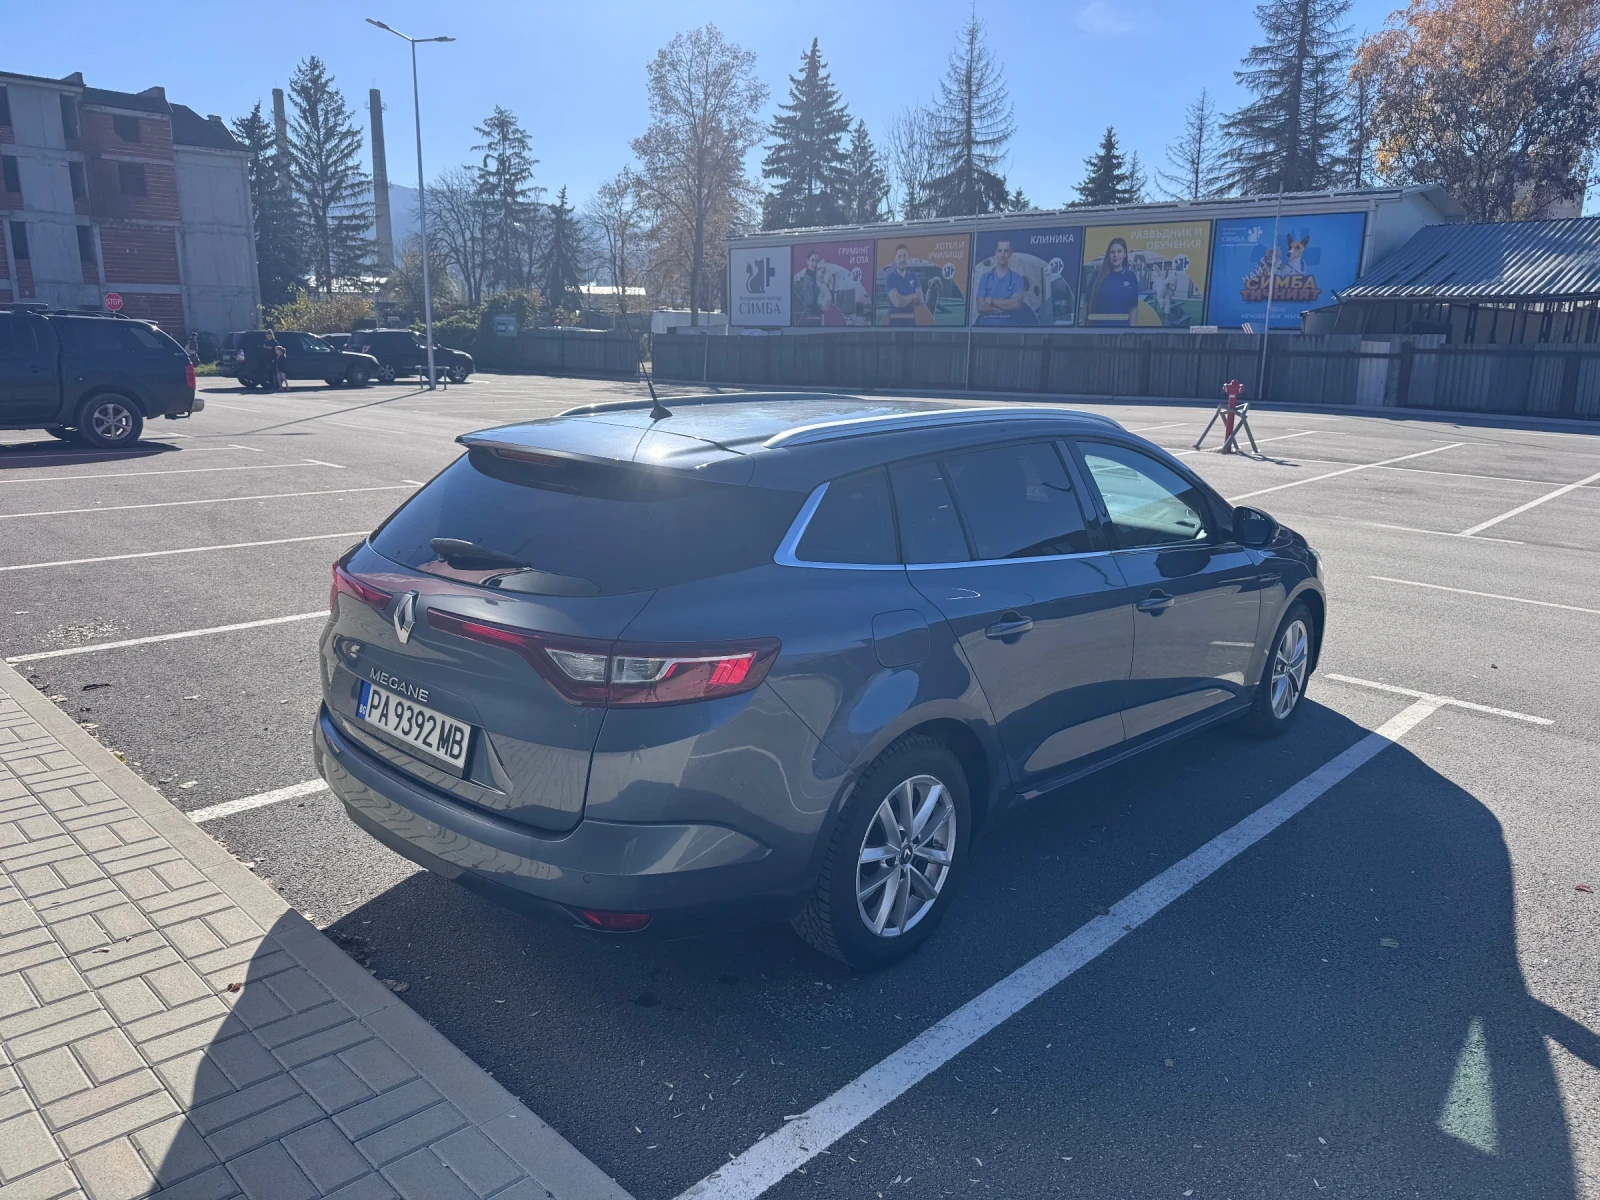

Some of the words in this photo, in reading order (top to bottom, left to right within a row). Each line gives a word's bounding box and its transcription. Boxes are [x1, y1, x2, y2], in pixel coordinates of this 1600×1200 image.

[1030, 233, 1075, 245] КЛИНИКА
[1130, 228, 1192, 239] РАЗВЪДНИК
[1195, 228, 1203, 237] И
[935, 242, 958, 250] ХОТЕЛ
[958, 241, 965, 249] И
[1146, 240, 1202, 250] ОБУЧЕНИЯ
[838, 246, 870, 256] ГРУМИНГ
[928, 250, 964, 260] УЧИЛИЩЕ
[849, 256, 855, 264] И
[856, 256, 869, 264] СПА
[1245, 275, 1317, 290] СИМБА
[1241, 288, 1322, 301] ТИЧНИЯТ
[105, 298, 122, 306] STOP
[739, 302, 782, 315] СИМБА
[369, 667, 430, 703] MEGANE
[359, 703, 367, 715] BG
[367, 689, 391, 728] PA
[393, 700, 438, 749] 9392
[436, 719, 466, 761] MB
